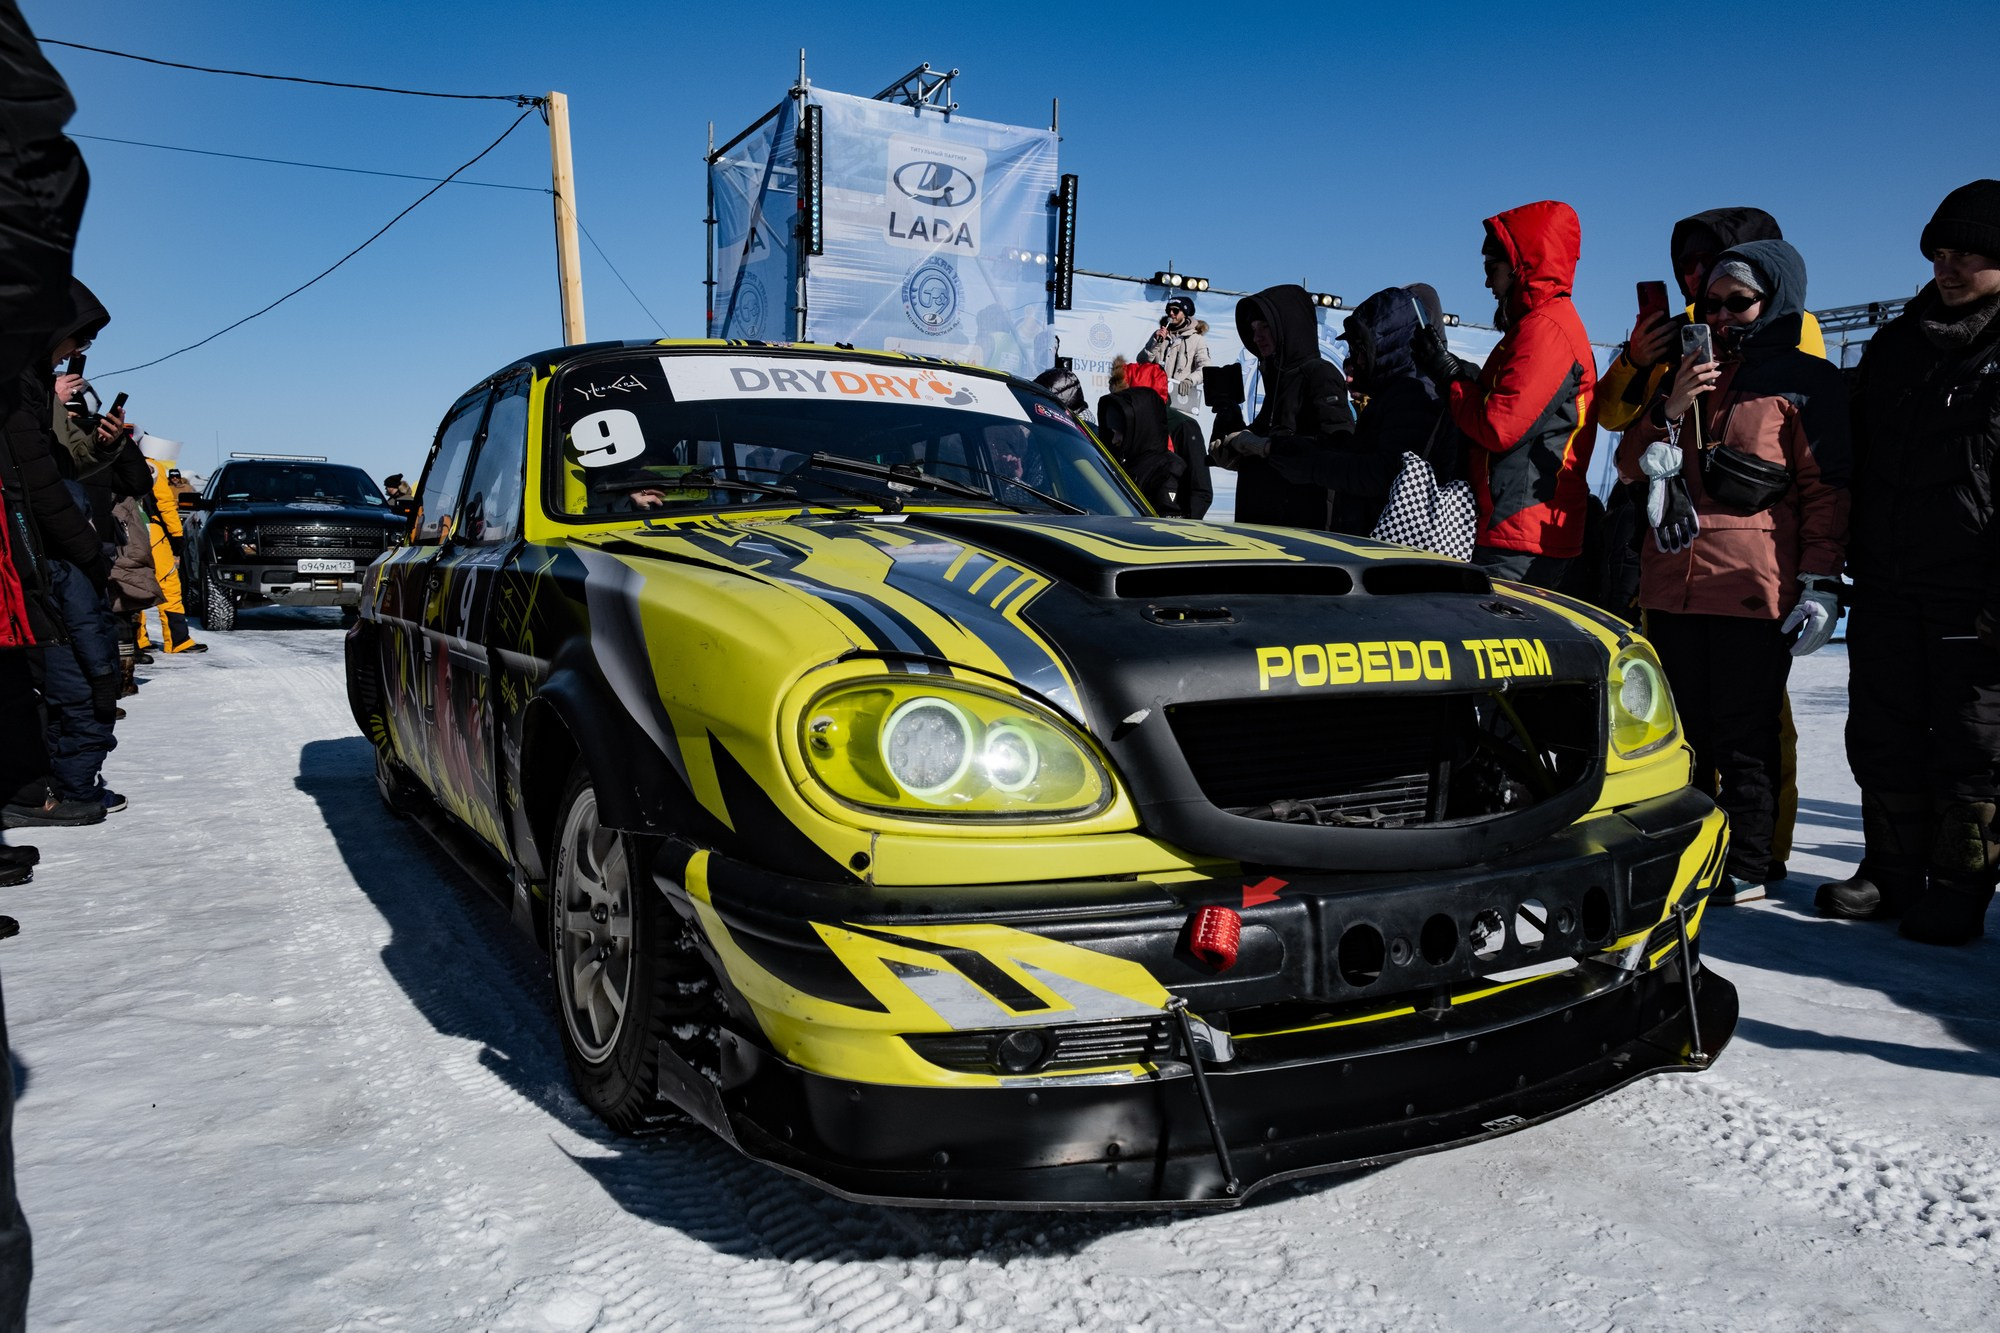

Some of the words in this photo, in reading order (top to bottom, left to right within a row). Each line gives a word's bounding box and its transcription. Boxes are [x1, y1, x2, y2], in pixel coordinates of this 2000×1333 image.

[944, 152, 967, 161] ПАРТНЕР
[889, 211, 974, 248] LADA
[1073, 358, 1112, 373] БУРЯТ
[571, 409, 646, 468] 9
[456, 564, 478, 650] 9
[1462, 639, 1553, 680] TEAM
